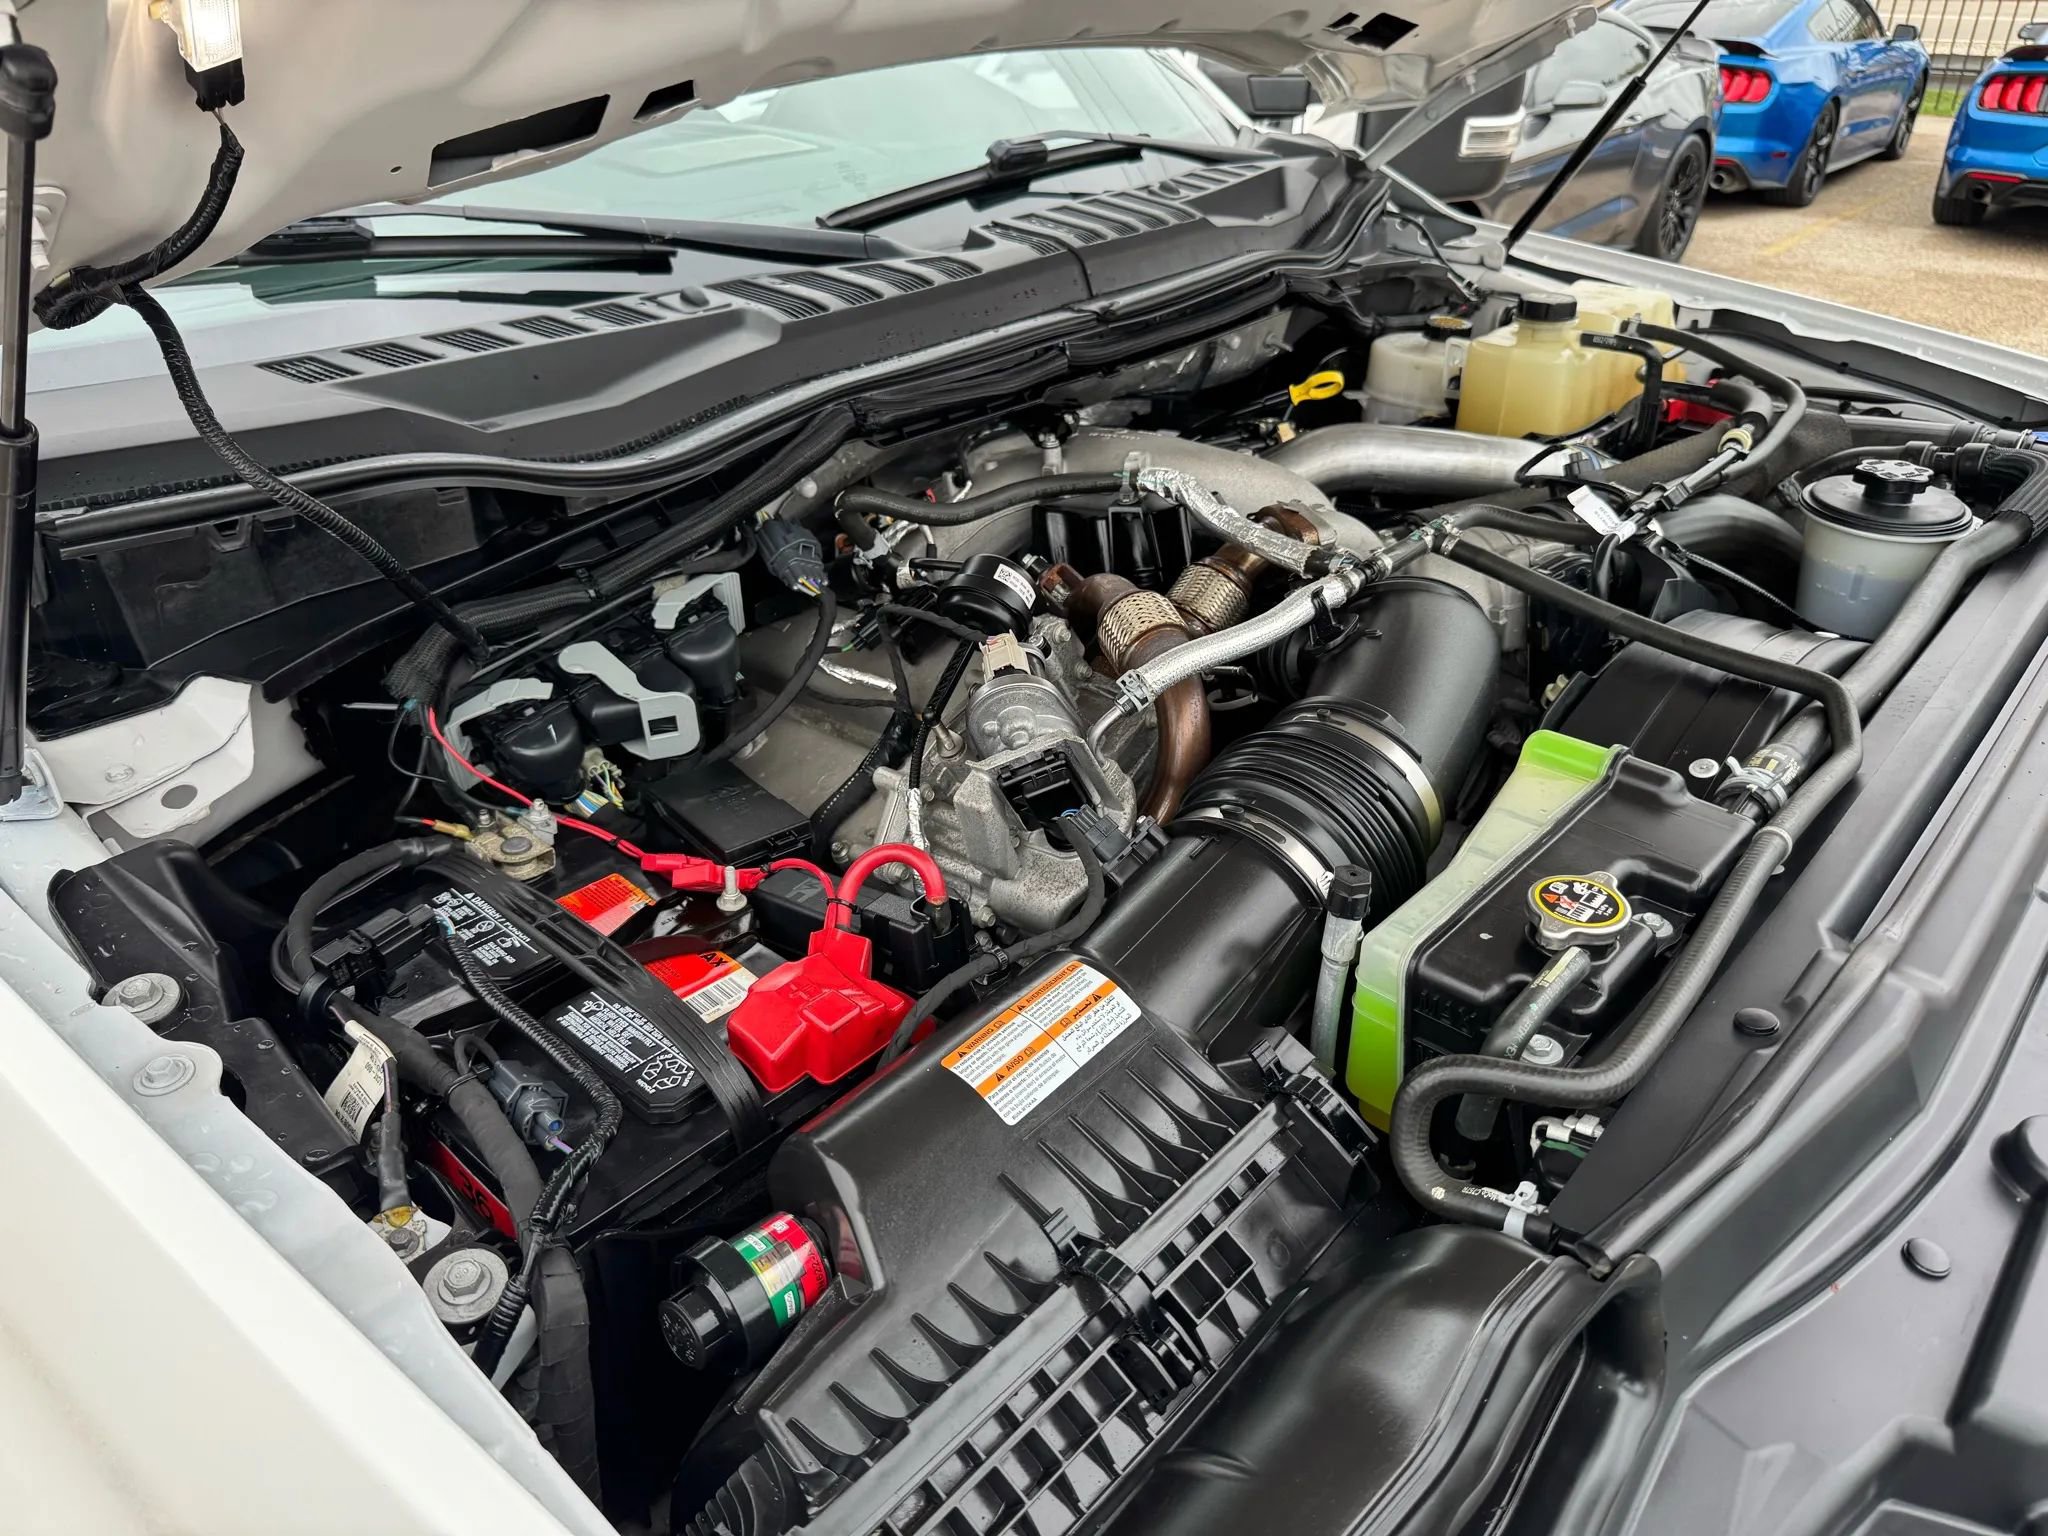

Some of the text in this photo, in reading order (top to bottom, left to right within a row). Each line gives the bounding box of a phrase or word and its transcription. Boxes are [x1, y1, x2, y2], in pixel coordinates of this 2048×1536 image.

[1026, 971, 1068, 1003] AVERTISSEMENT
[601, 1008, 619, 1020] FLUSH
[614, 1017, 630, 1028] EYES
[625, 1025, 657, 1048] IMMEDIATELY
[965, 1027, 995, 1051] WARNING
[616, 1036, 632, 1047] FAST
[1004, 1054, 1025, 1072] AVISO
